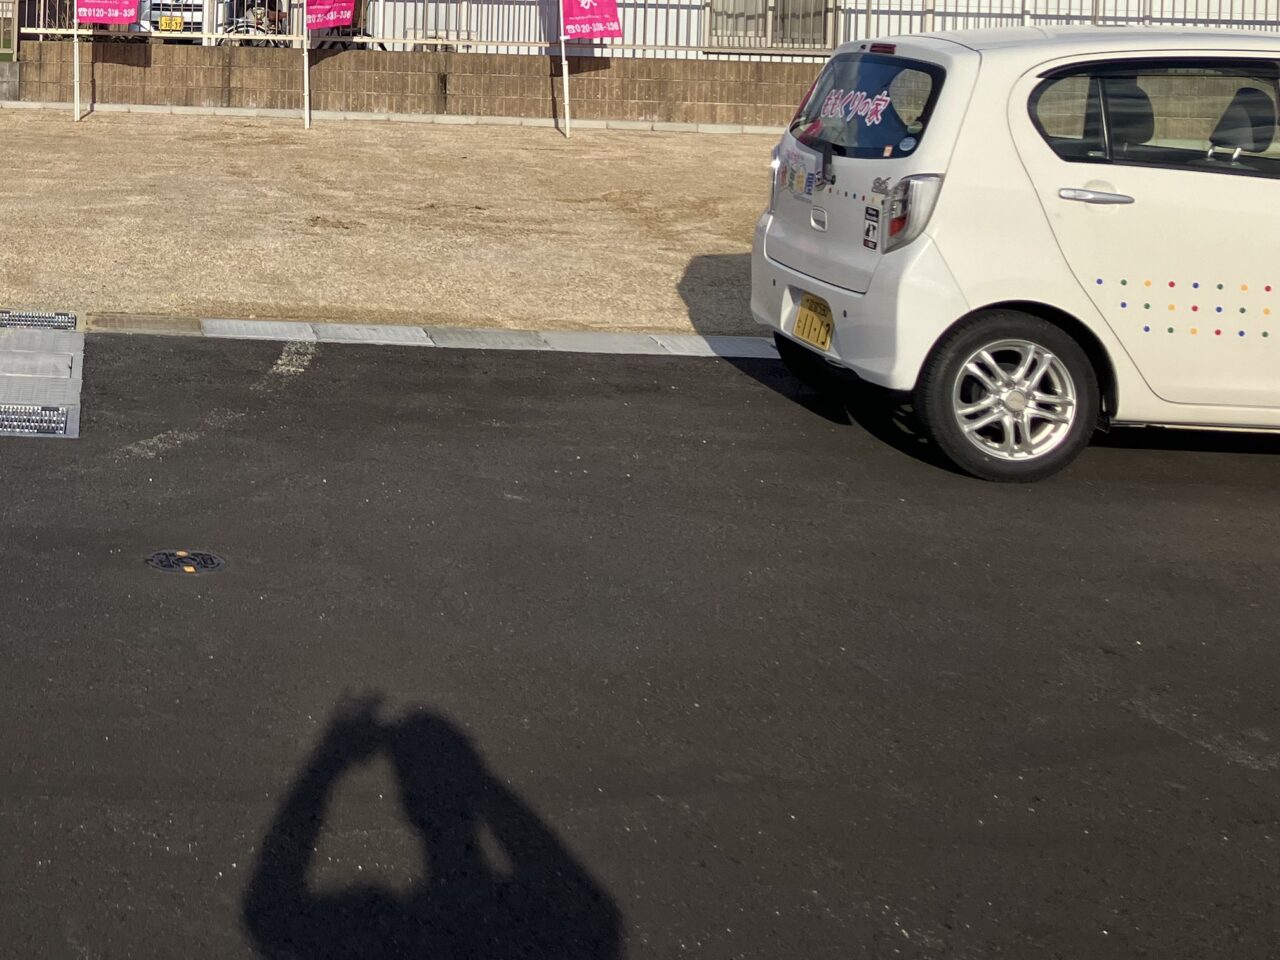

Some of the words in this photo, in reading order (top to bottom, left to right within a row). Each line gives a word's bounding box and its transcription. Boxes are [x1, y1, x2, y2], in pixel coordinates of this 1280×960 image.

[821, 88, 891, 127] ももくりの家
